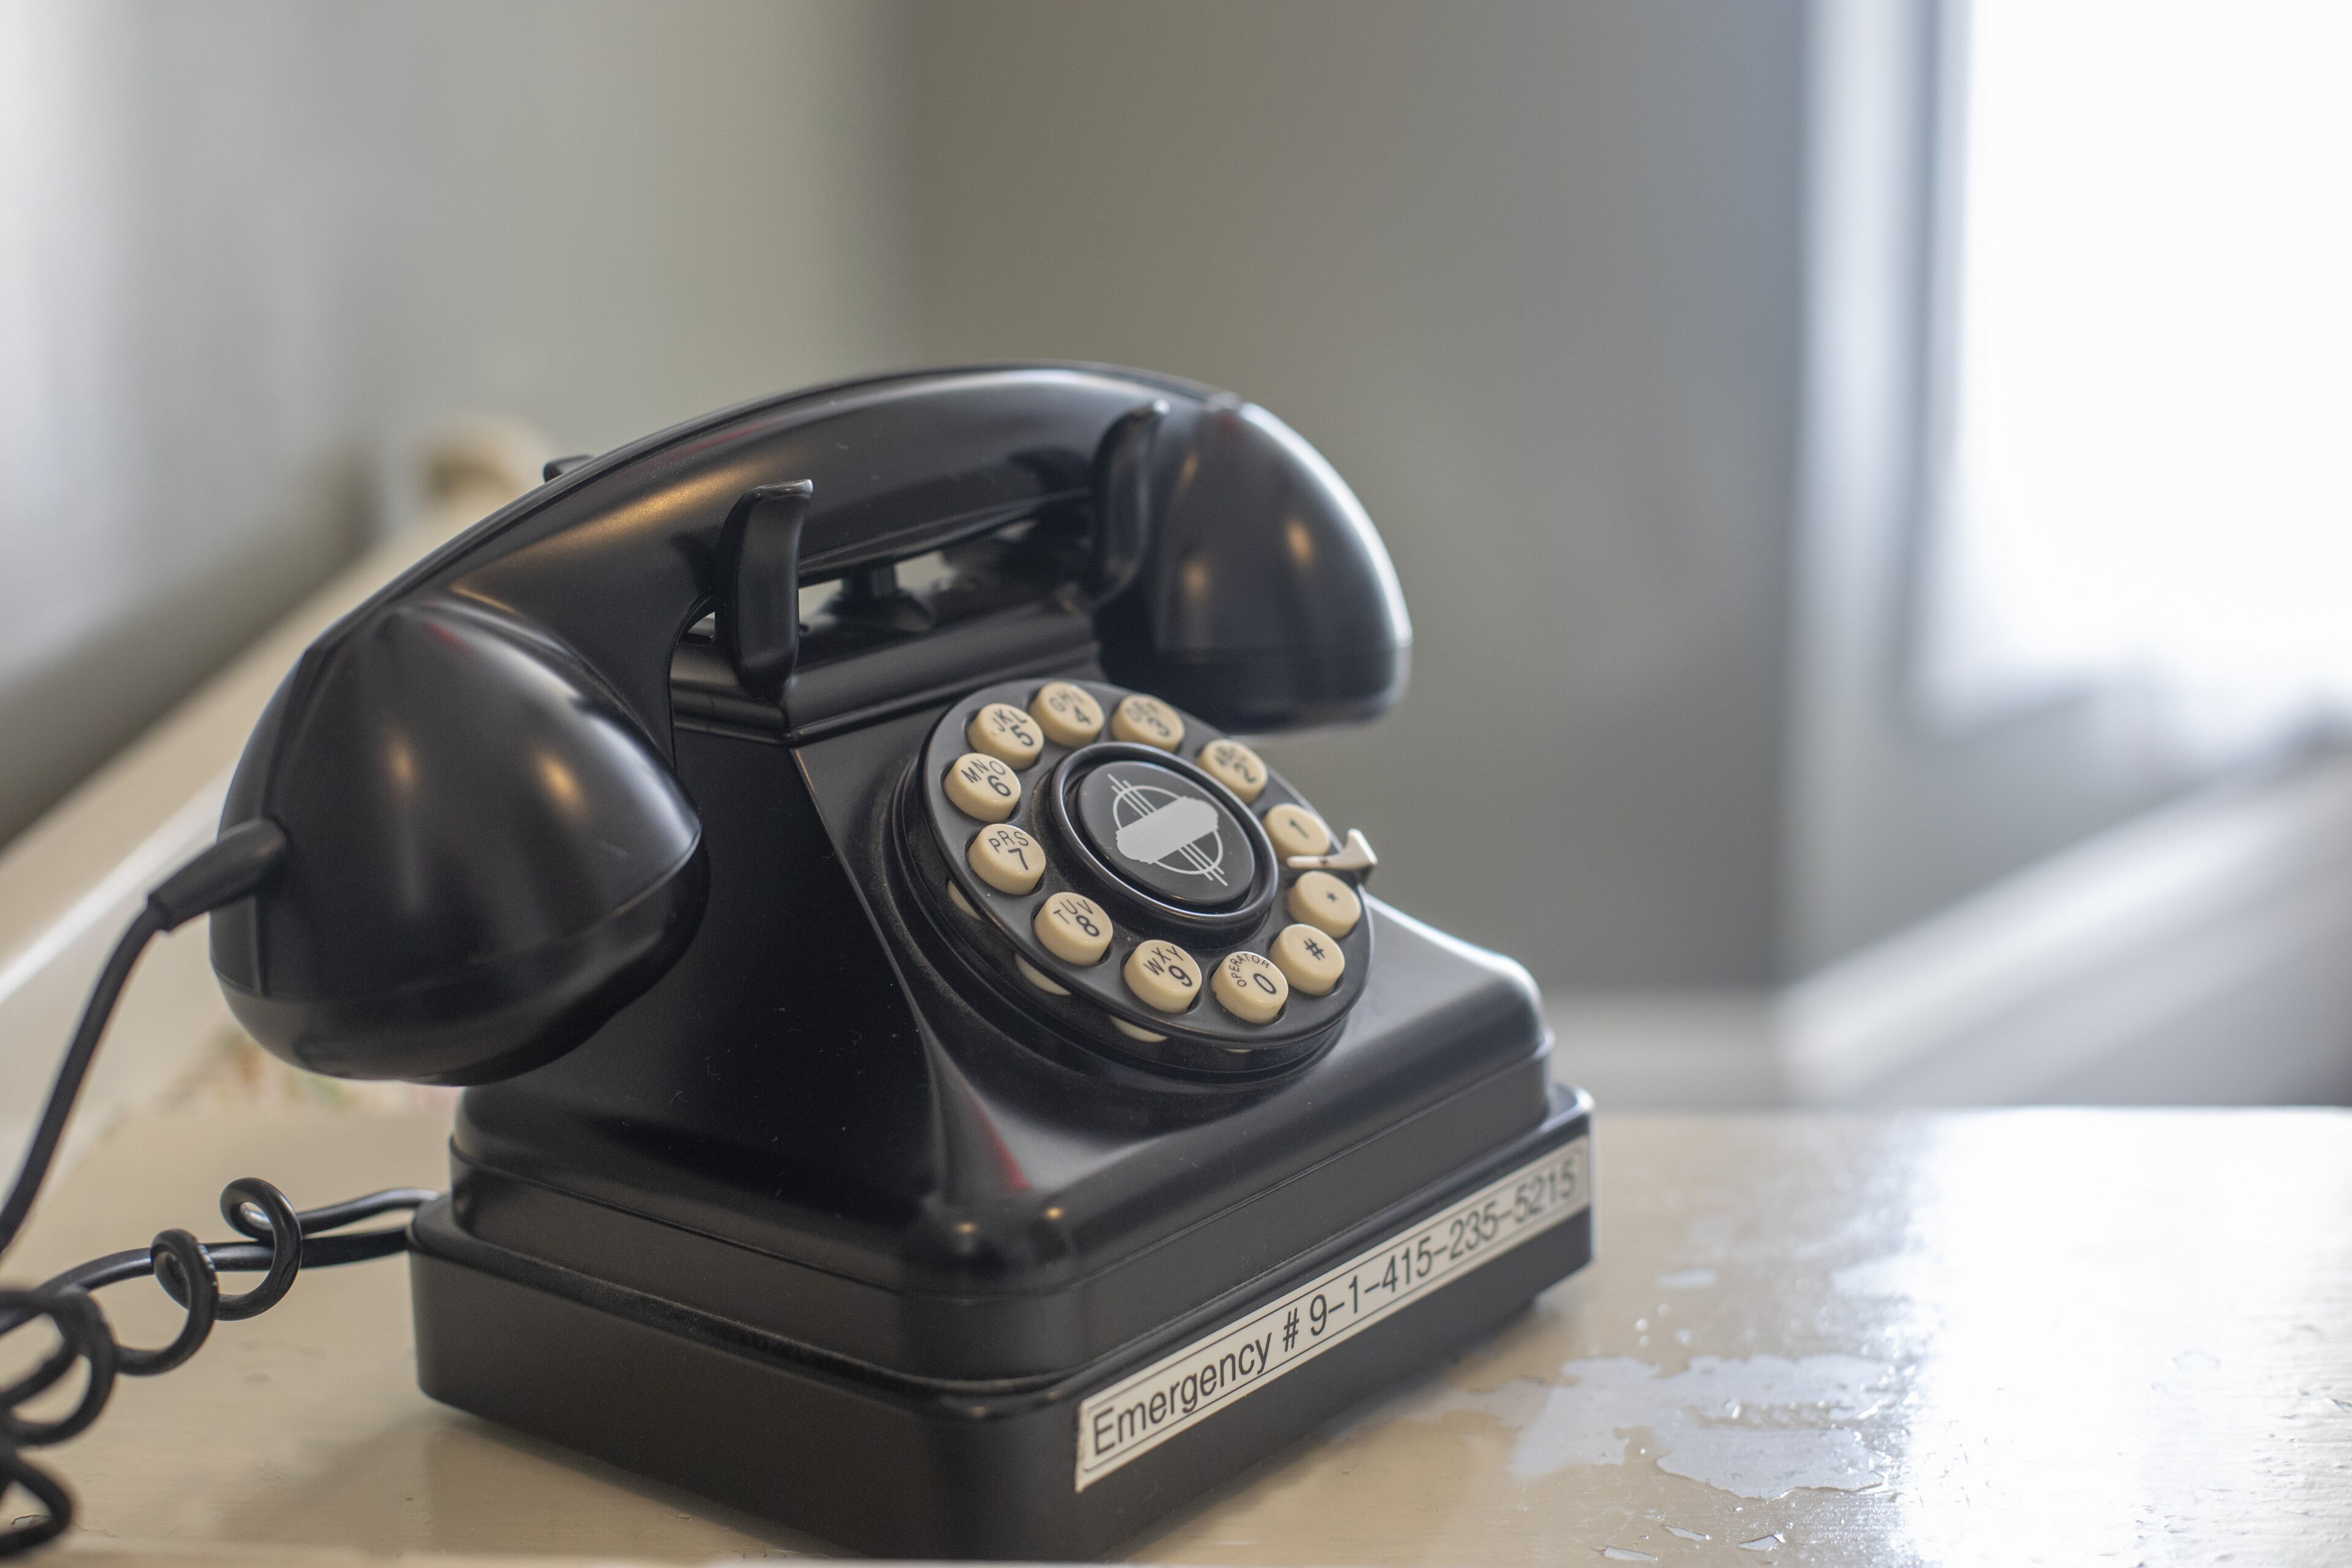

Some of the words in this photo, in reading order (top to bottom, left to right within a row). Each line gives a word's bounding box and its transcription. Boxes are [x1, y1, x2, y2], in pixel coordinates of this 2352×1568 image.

[992, 708, 1028, 733] JKL
[1072, 705, 1091, 725] 4
[1147, 716, 1170, 737] 3
[1010, 724, 1035, 747] 5
[960, 758, 1006, 784] MNO
[1233, 762, 1257, 784] 2
[987, 775, 1011, 797] 6
[1289, 818, 1309, 839] 1
[988, 830, 1029, 853] PRS
[1008, 848, 1029, 870] 7
[1053, 899, 1094, 925] TUV
[1076, 914, 1101, 937] 8
[1143, 945, 1184, 976] WXY
[1229, 952, 1270, 987] OPERATOR
[1168, 965, 1193, 987] 9
[1253, 973, 1277, 995] 0
[1093, 1331, 1273, 1457] Emergency
[1282, 1306, 1300, 1353] #
[1309, 1158, 1578, 1337] 9-1-415-235-5215
